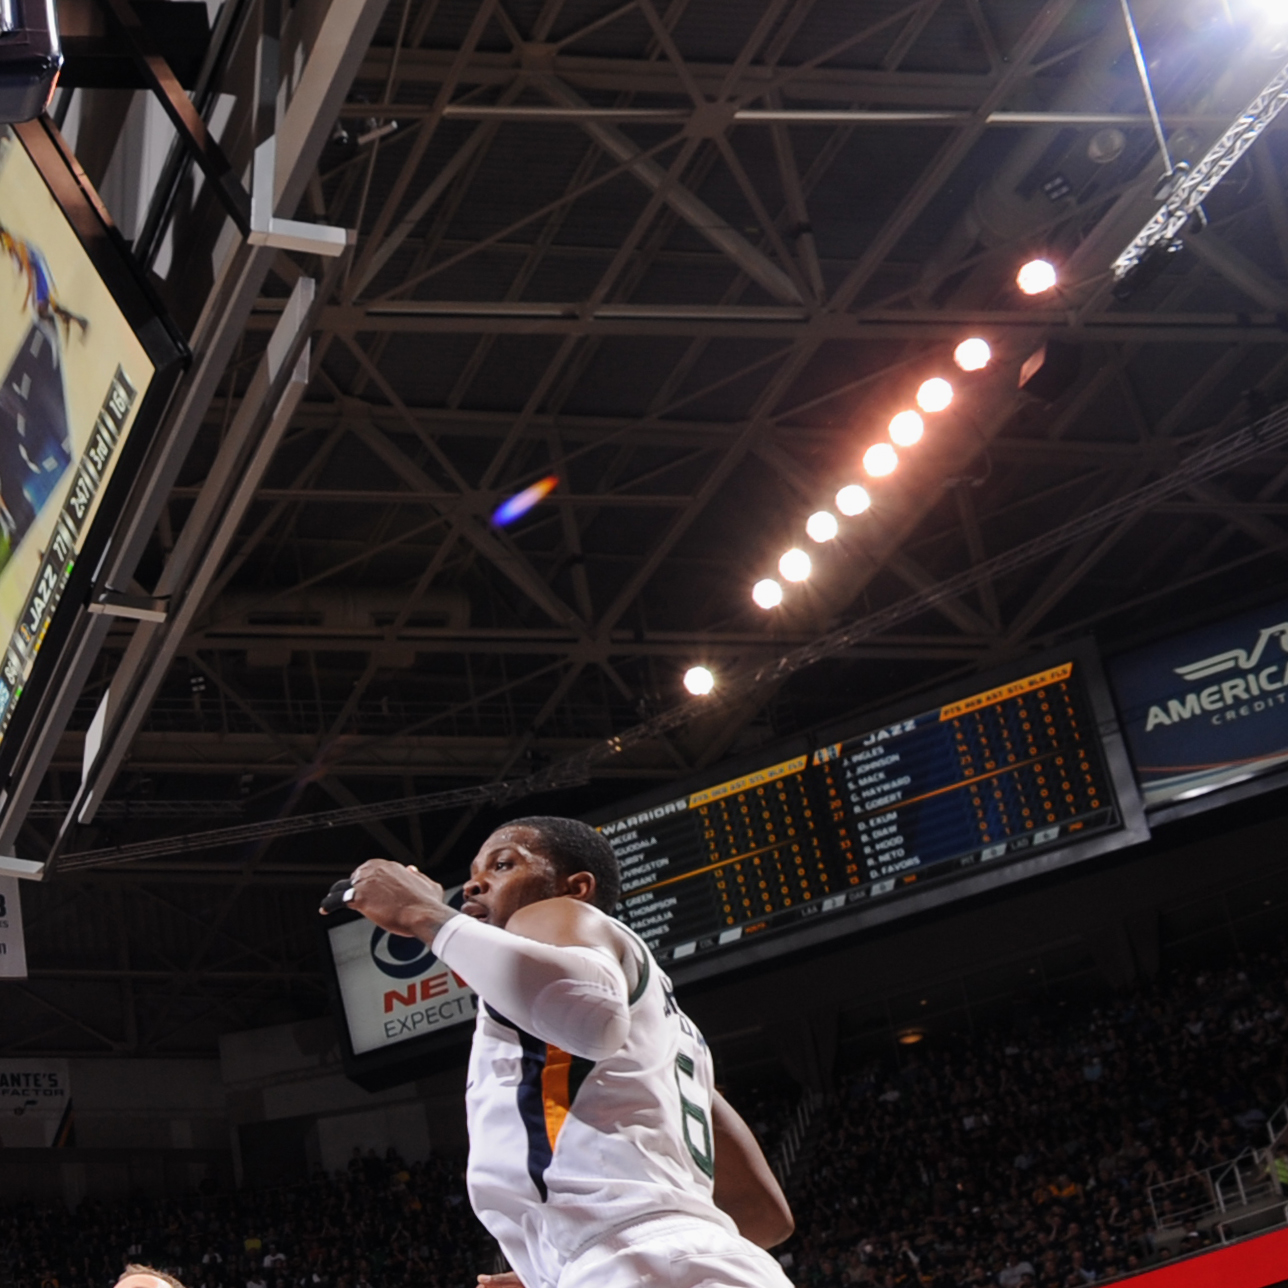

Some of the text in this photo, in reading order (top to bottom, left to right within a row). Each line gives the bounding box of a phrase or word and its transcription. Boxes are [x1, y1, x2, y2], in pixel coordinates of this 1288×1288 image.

[29, 565, 58, 632] JAZZ
[1211, 693, 1287, 726] CREDIT
[863, 719, 917, 746] JAZZ
[851, 746, 885, 764] INGLES
[855, 753, 900, 776] JOHNSON
[858, 772, 886, 788] MACK
[861, 775, 911, 800] HAYWARD
[864, 791, 903, 811] GOBERT
[601, 799, 688, 837] WARRIORS
[868, 811, 898, 828] EXUM
[871, 824, 898, 840] DIAW
[875, 835, 904, 852] HOOD
[877, 848, 905, 864] NETO
[880, 857, 921, 876] FAVORS
[384, 998, 467, 1039] EXPECT
